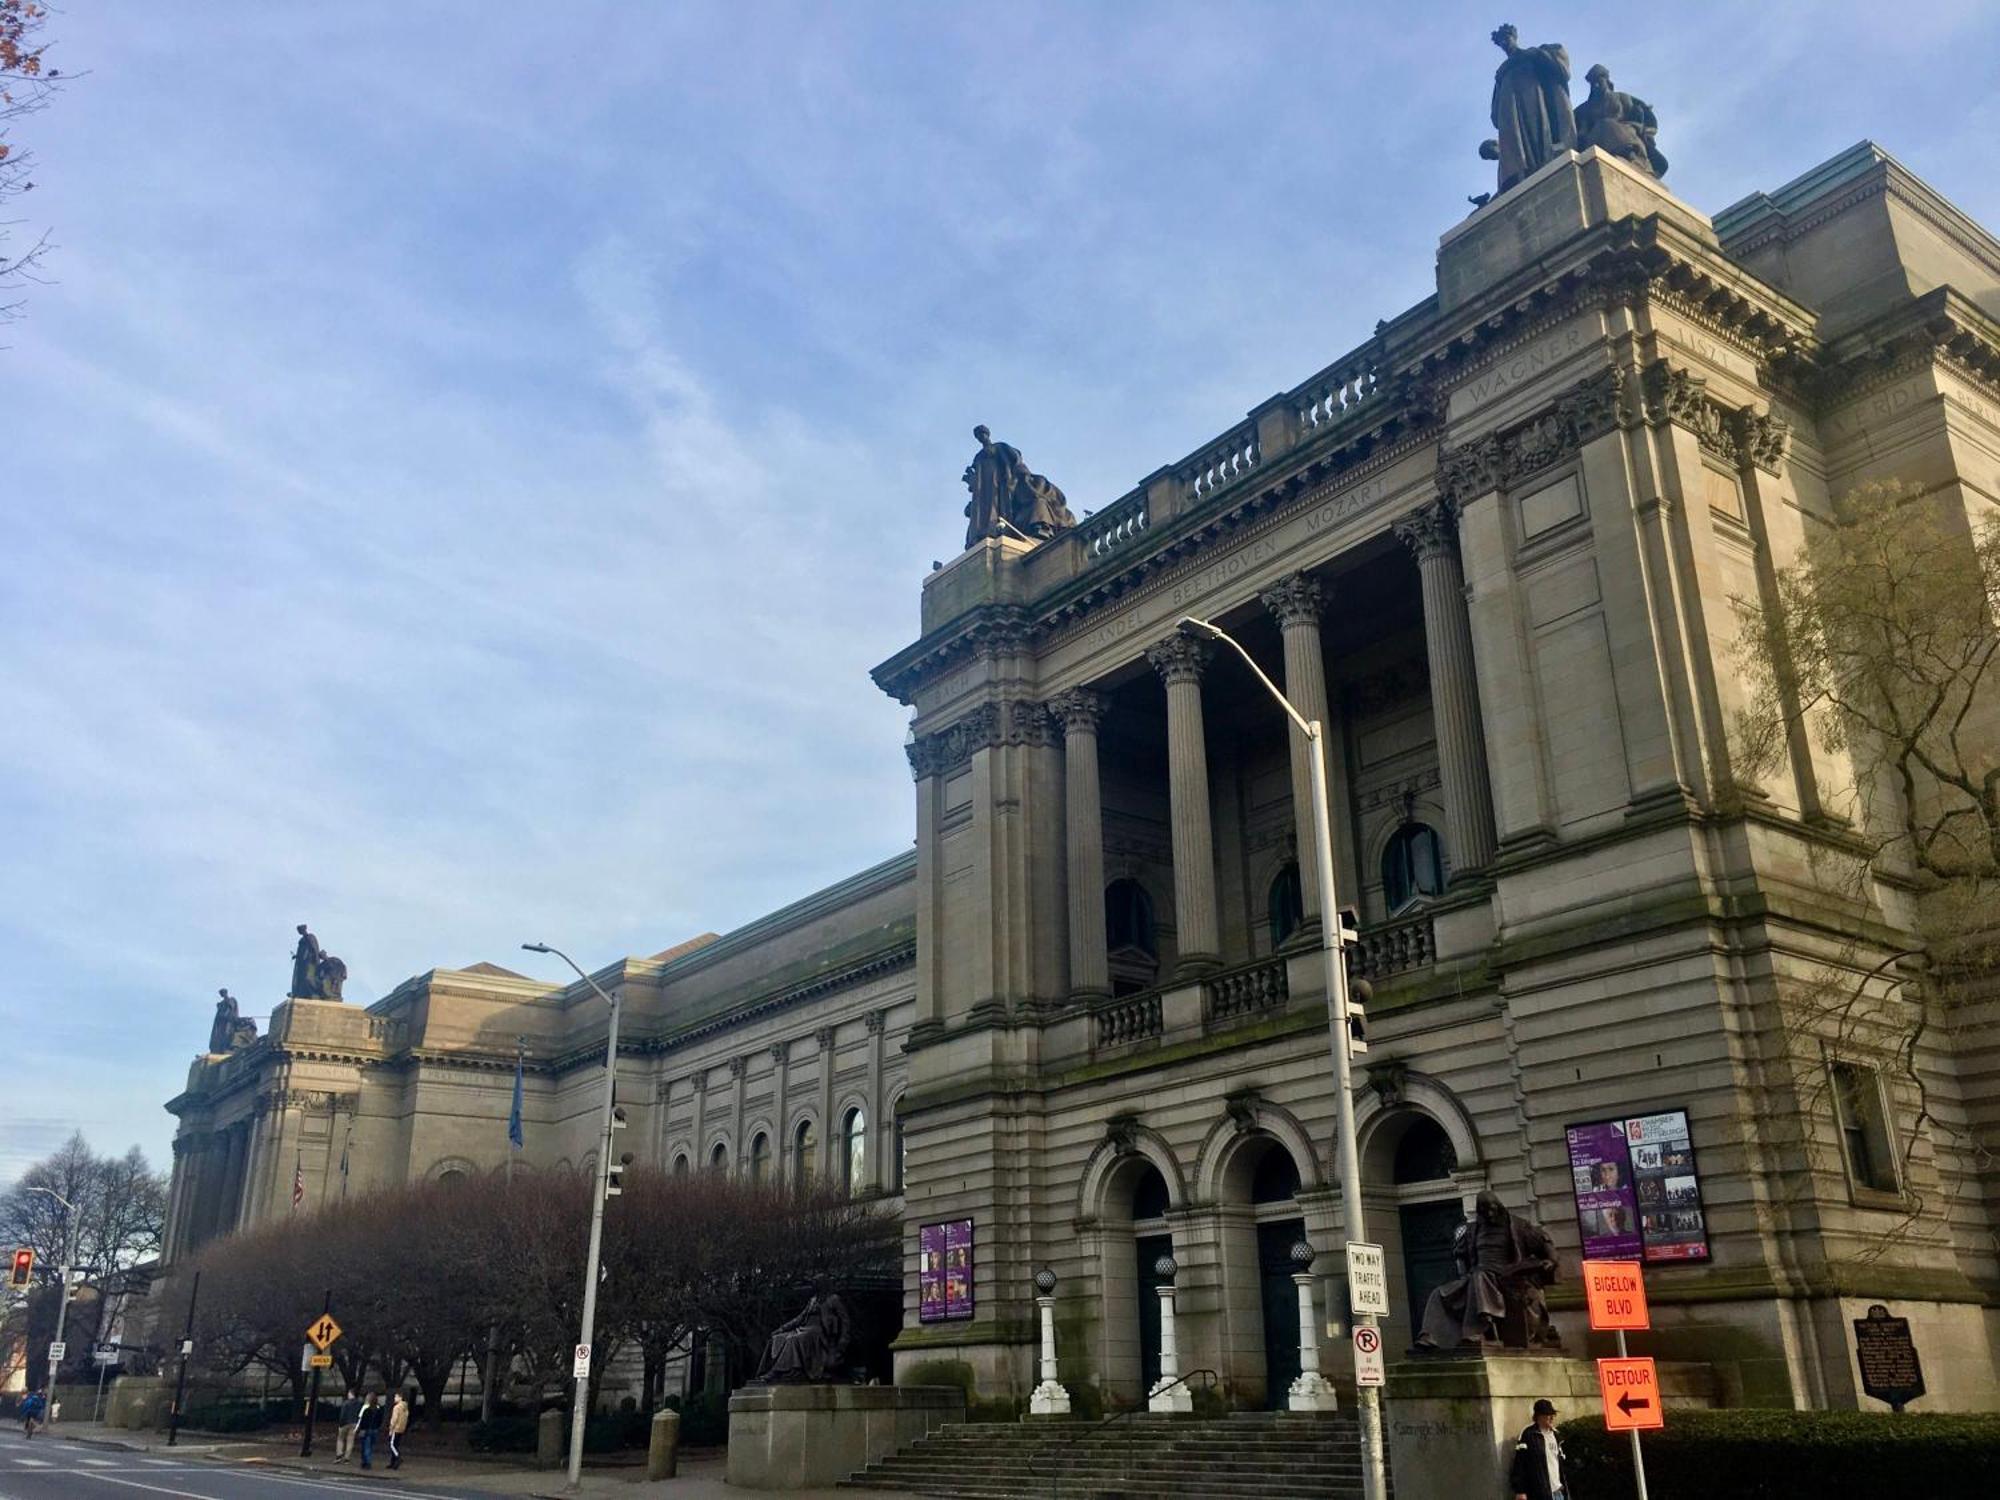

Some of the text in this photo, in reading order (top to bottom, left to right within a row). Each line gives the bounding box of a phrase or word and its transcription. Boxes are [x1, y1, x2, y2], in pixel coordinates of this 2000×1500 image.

[1470, 330, 1579, 402] WAGNER
[1833, 383, 1918, 434] VERDI
[1173, 537, 1276, 604] BEETHOVEN
[1306, 477, 1386, 532] MOZART
[1352, 1252, 1380, 1267] TWO WAY
[1354, 1272, 1381, 1286] TRAFFIC
[1594, 1276, 1637, 1292] BIGELOW
[1359, 1290, 1380, 1304] AHEAD
[1607, 1300, 1632, 1315] BLVD
[1607, 1369, 1651, 1386] DETOUR
